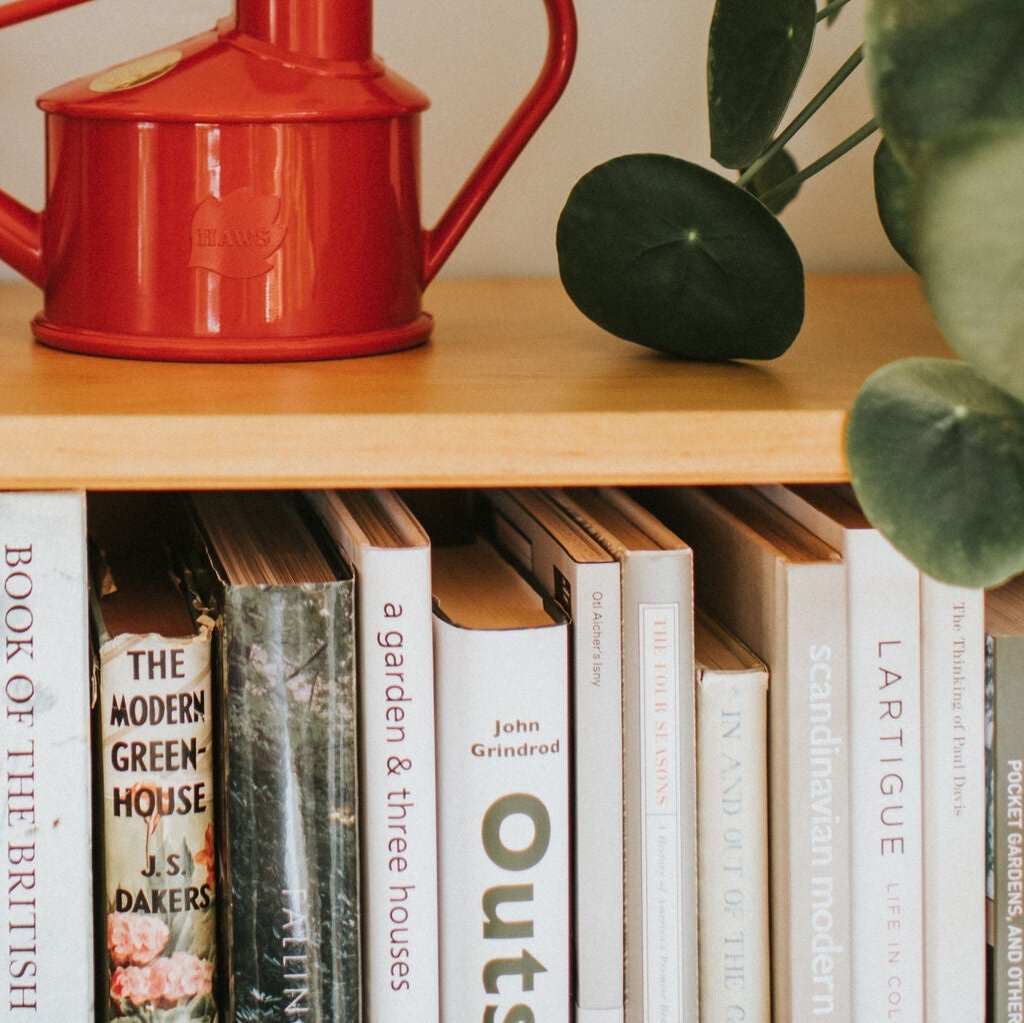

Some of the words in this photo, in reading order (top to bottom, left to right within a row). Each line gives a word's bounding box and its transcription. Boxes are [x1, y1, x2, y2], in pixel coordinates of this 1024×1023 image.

[197, 227, 270, 247] HAWS
[4, 544, 34, 662] BOOK
[383, 602, 403, 619] a
[952, 601, 966, 634] The
[653, 618, 668, 656] THE
[126, 648, 186, 681] THE
[376, 629, 412, 743] garden
[590, 663, 603, 688] Isny
[654, 663, 668, 713] FOUR
[952, 637, 966, 711] Thinking
[5, 674, 35, 728] OF
[110, 690, 206, 727] MODERN
[720, 709, 743, 740] IN
[952, 714, 966, 732] of
[470, 738, 560, 758] Grindrod
[493, 719, 540, 737] John
[877, 640, 905, 857] LARTIGUE
[111, 737, 207, 772] GREEN-
[386, 755, 413, 777] &
[655, 721, 669, 806] SEASONS
[808, 644, 842, 866] scandinavian
[952, 736, 966, 770] Paul
[6, 740, 37, 827] THE
[113, 782, 207, 818] HOUSE
[720, 752, 744, 817] AND
[952, 776, 966, 818] Davis
[1006, 759, 1023, 829] POCKET
[386, 787, 414, 873] three
[722, 827, 745, 879] OUT
[140, 855, 162, 877] J.
[166, 854, 187, 876] S.
[1005, 832, 1024, 922] GARDENS,
[116, 883, 211, 914] DAKERS
[886, 882, 902, 931] LIFE
[7, 842, 38, 1012] BRITISH
[388, 884, 416, 992] houses
[810, 876, 844, 1015] modern
[1007, 924, 1023, 963] AND
[281, 888, 310, 1016] FALLIN
[723, 930, 746, 989] THE
[887, 941, 901, 965] IN
[886, 975, 903, 1023] COL
[1007, 966, 1024, 1023] OTHER
